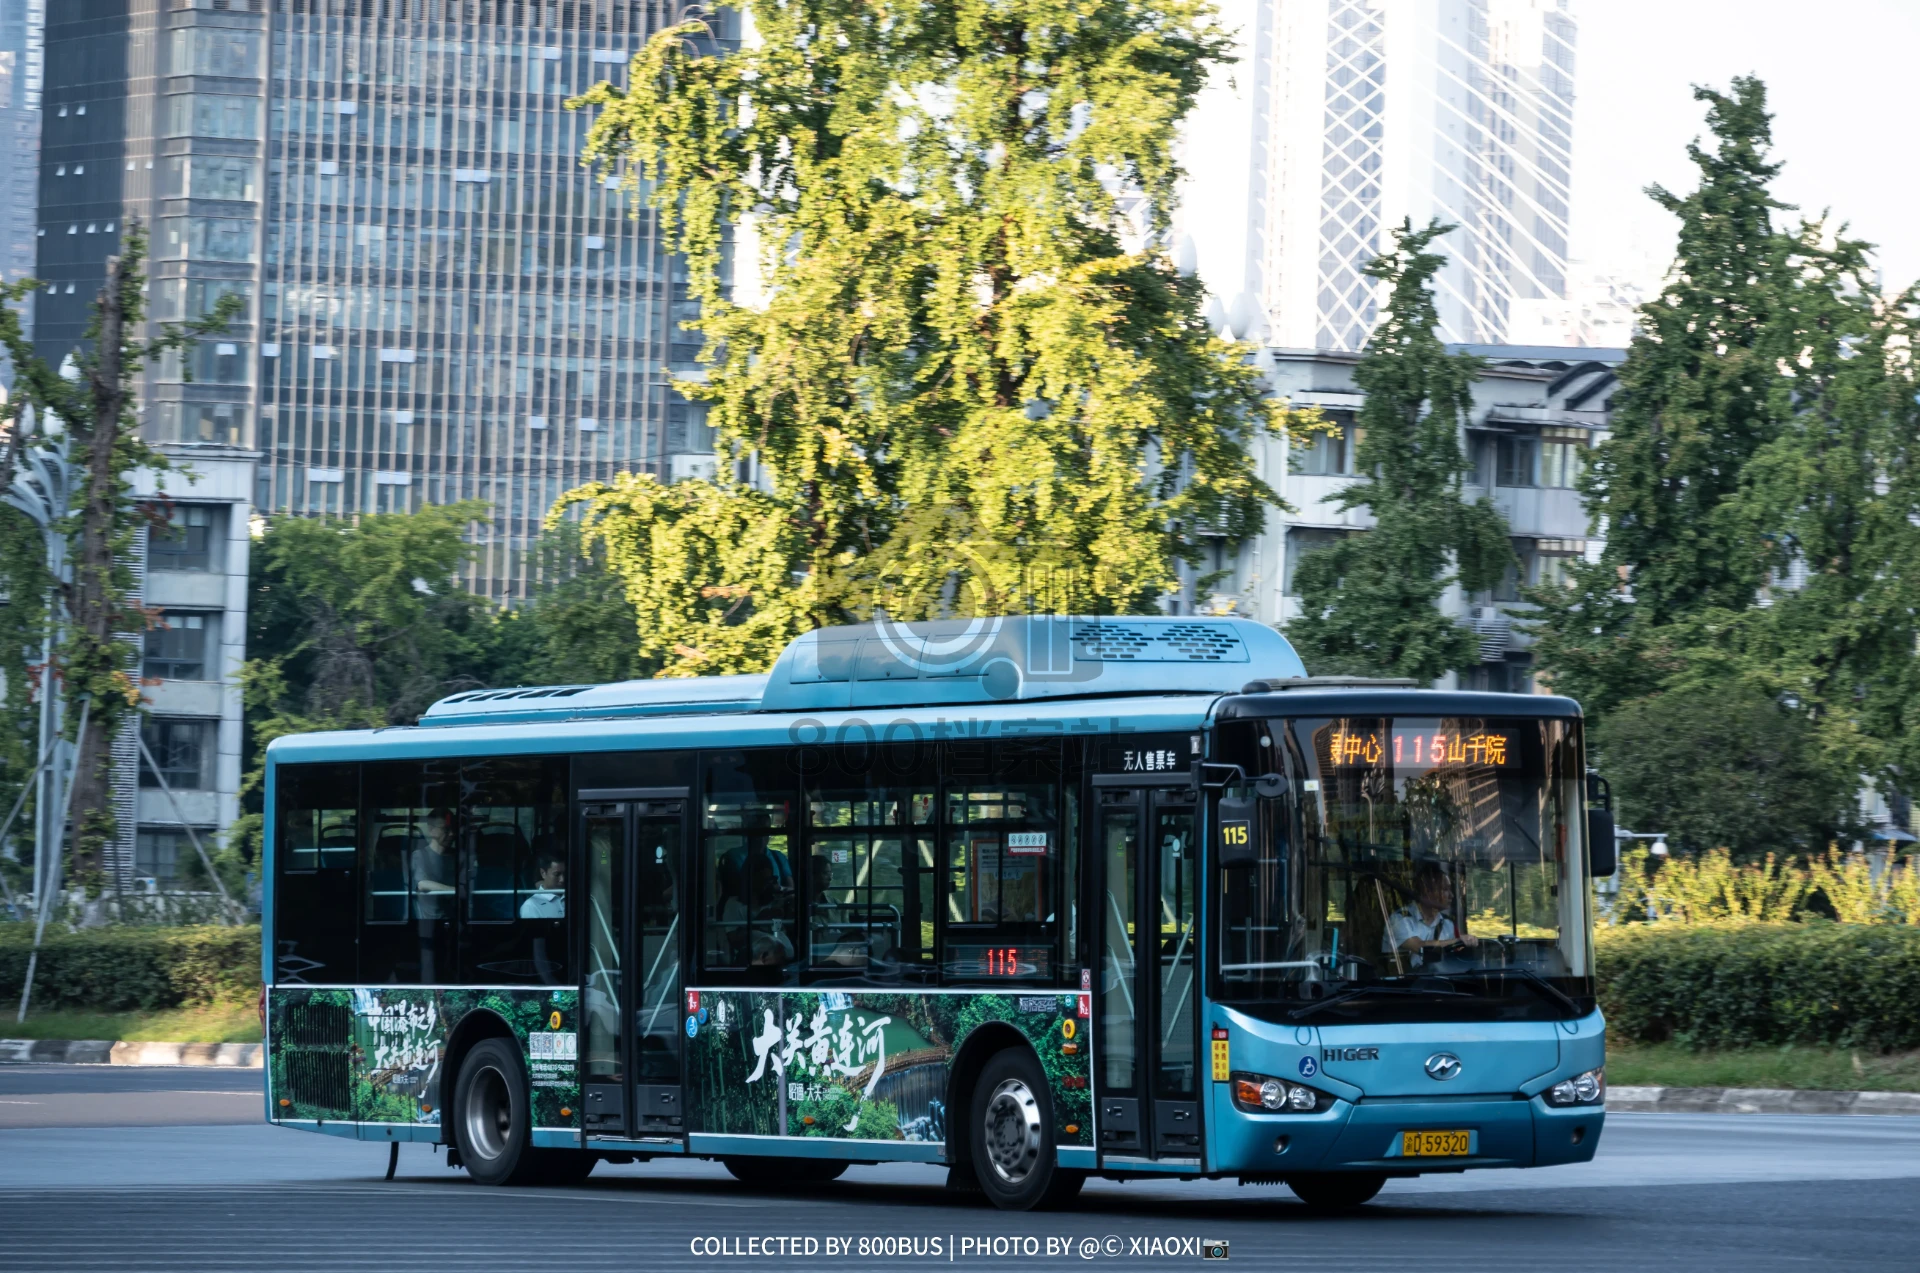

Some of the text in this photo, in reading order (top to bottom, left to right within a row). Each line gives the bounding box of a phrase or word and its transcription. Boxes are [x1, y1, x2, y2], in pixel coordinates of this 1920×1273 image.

[1394, 735, 1447, 763] 115
[1448, 734, 1507, 764] 山千院
[1123, 750, 1176, 770] 无人售票车
[1223, 826, 1248, 845] 115
[987, 949, 1017, 975] 115
[1323, 1047, 1379, 1062] HIGER
